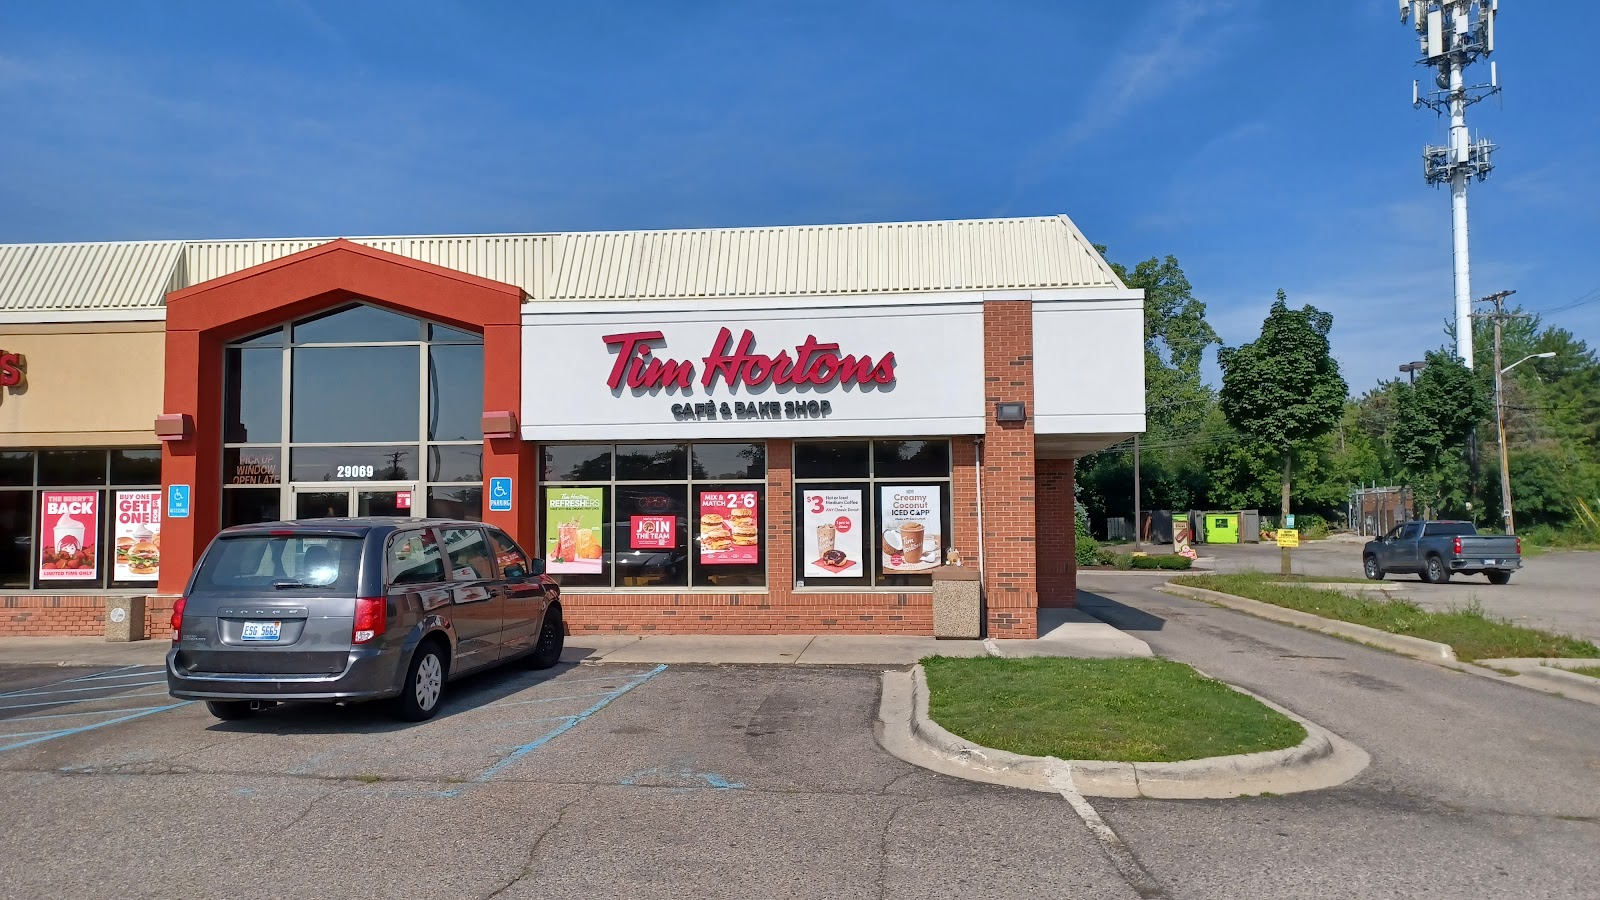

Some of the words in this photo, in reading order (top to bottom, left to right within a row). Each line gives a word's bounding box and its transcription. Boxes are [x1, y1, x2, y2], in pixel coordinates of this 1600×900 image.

[602, 331, 692, 389] Tim
[701, 327, 896, 386] Hortons
[671, 399, 715, 418] CAFÉ
[719, 401, 732, 418] &
[735, 400, 780, 418] BAKE
[784, 399, 831, 417] SHOP
[240, 455, 259, 465] PICK
[262, 455, 273, 464] UP
[236, 465, 276, 475] WINDOW
[337, 465, 373, 478] 29069
[233, 475, 257, 484] OPEN
[258, 474, 280, 484] LATE
[550, 499, 600, 507] REFRESHERS
[727, 493, 737, 508] 2
[807, 495, 825, 514] $3
[893, 494, 927, 503] Creamy
[47, 502, 93, 514] BACK
[119, 500, 150, 512] GET
[119, 512, 150, 524] ONE
[636, 521, 670, 533] JOIN
